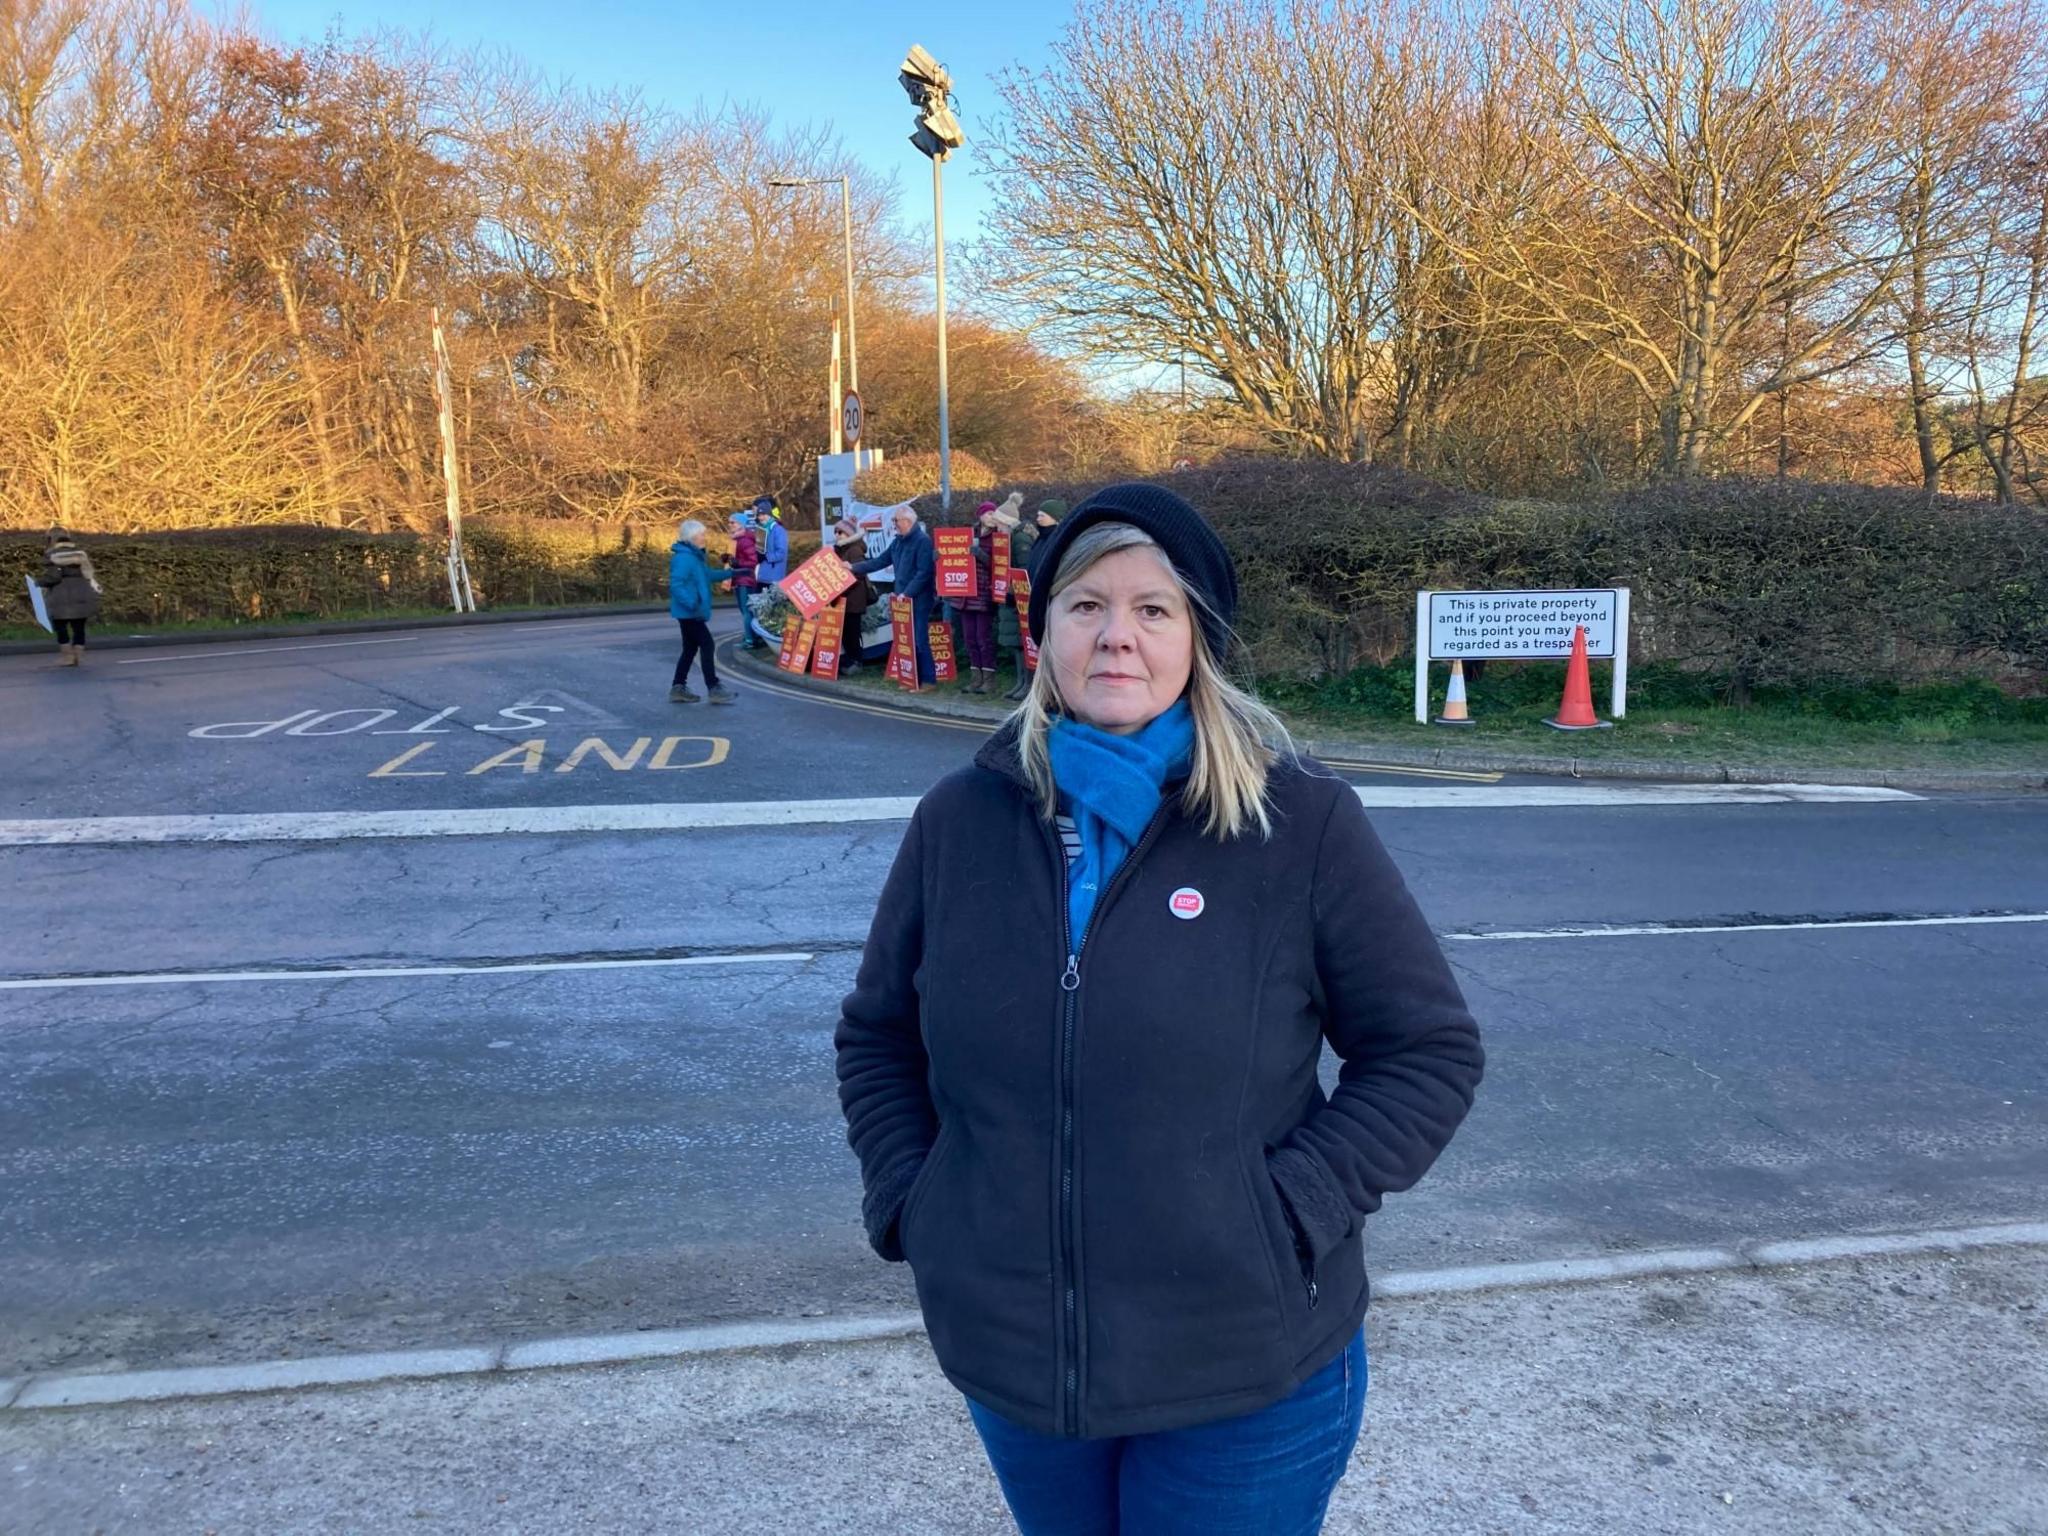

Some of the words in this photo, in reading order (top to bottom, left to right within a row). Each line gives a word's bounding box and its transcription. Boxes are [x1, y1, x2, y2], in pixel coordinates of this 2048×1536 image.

[845, 408, 859, 431] 20
[953, 535, 969, 544] NOT
[948, 547, 969, 555] SIMPL
[824, 552, 849, 581] ROAD
[953, 559, 968, 567] ABC
[814, 556, 844, 591] WORKS
[945, 572, 969, 582] STOP
[794, 580, 817, 603] STOP
[800, 569, 829, 601] AHEAD
[1449, 599, 1476, 609] This
[1479, 599, 1490, 609] is
[1493, 598, 1537, 611] private
[1541, 597, 1597, 610] property
[1439, 612, 1462, 623] and
[1466, 612, 1475, 623] if
[1478, 614, 1501, 624] you
[1505, 611, 1556, 623] proceed
[1560, 610, 1607, 623] beyond
[928, 624, 945, 634] AD
[1454, 626, 1477, 636] this
[1481, 625, 1514, 637] point
[1518, 627, 1540, 637] you
[1544, 627, 1571, 637] may
[928, 634, 950, 644] RKS
[1443, 639, 1500, 651] regarded
[1504, 640, 1518, 649] as
[1522, 640, 1529, 649] a
[1534, 638, 1601, 650] trespaer
[818, 650, 835, 663] STOP
[932, 651, 951, 661] EAD
[934, 662, 948, 672] OP
[187, 705, 566, 738] STOP
[367, 736, 730, 777] LAND
[1177, 897, 1197, 905] STOP
